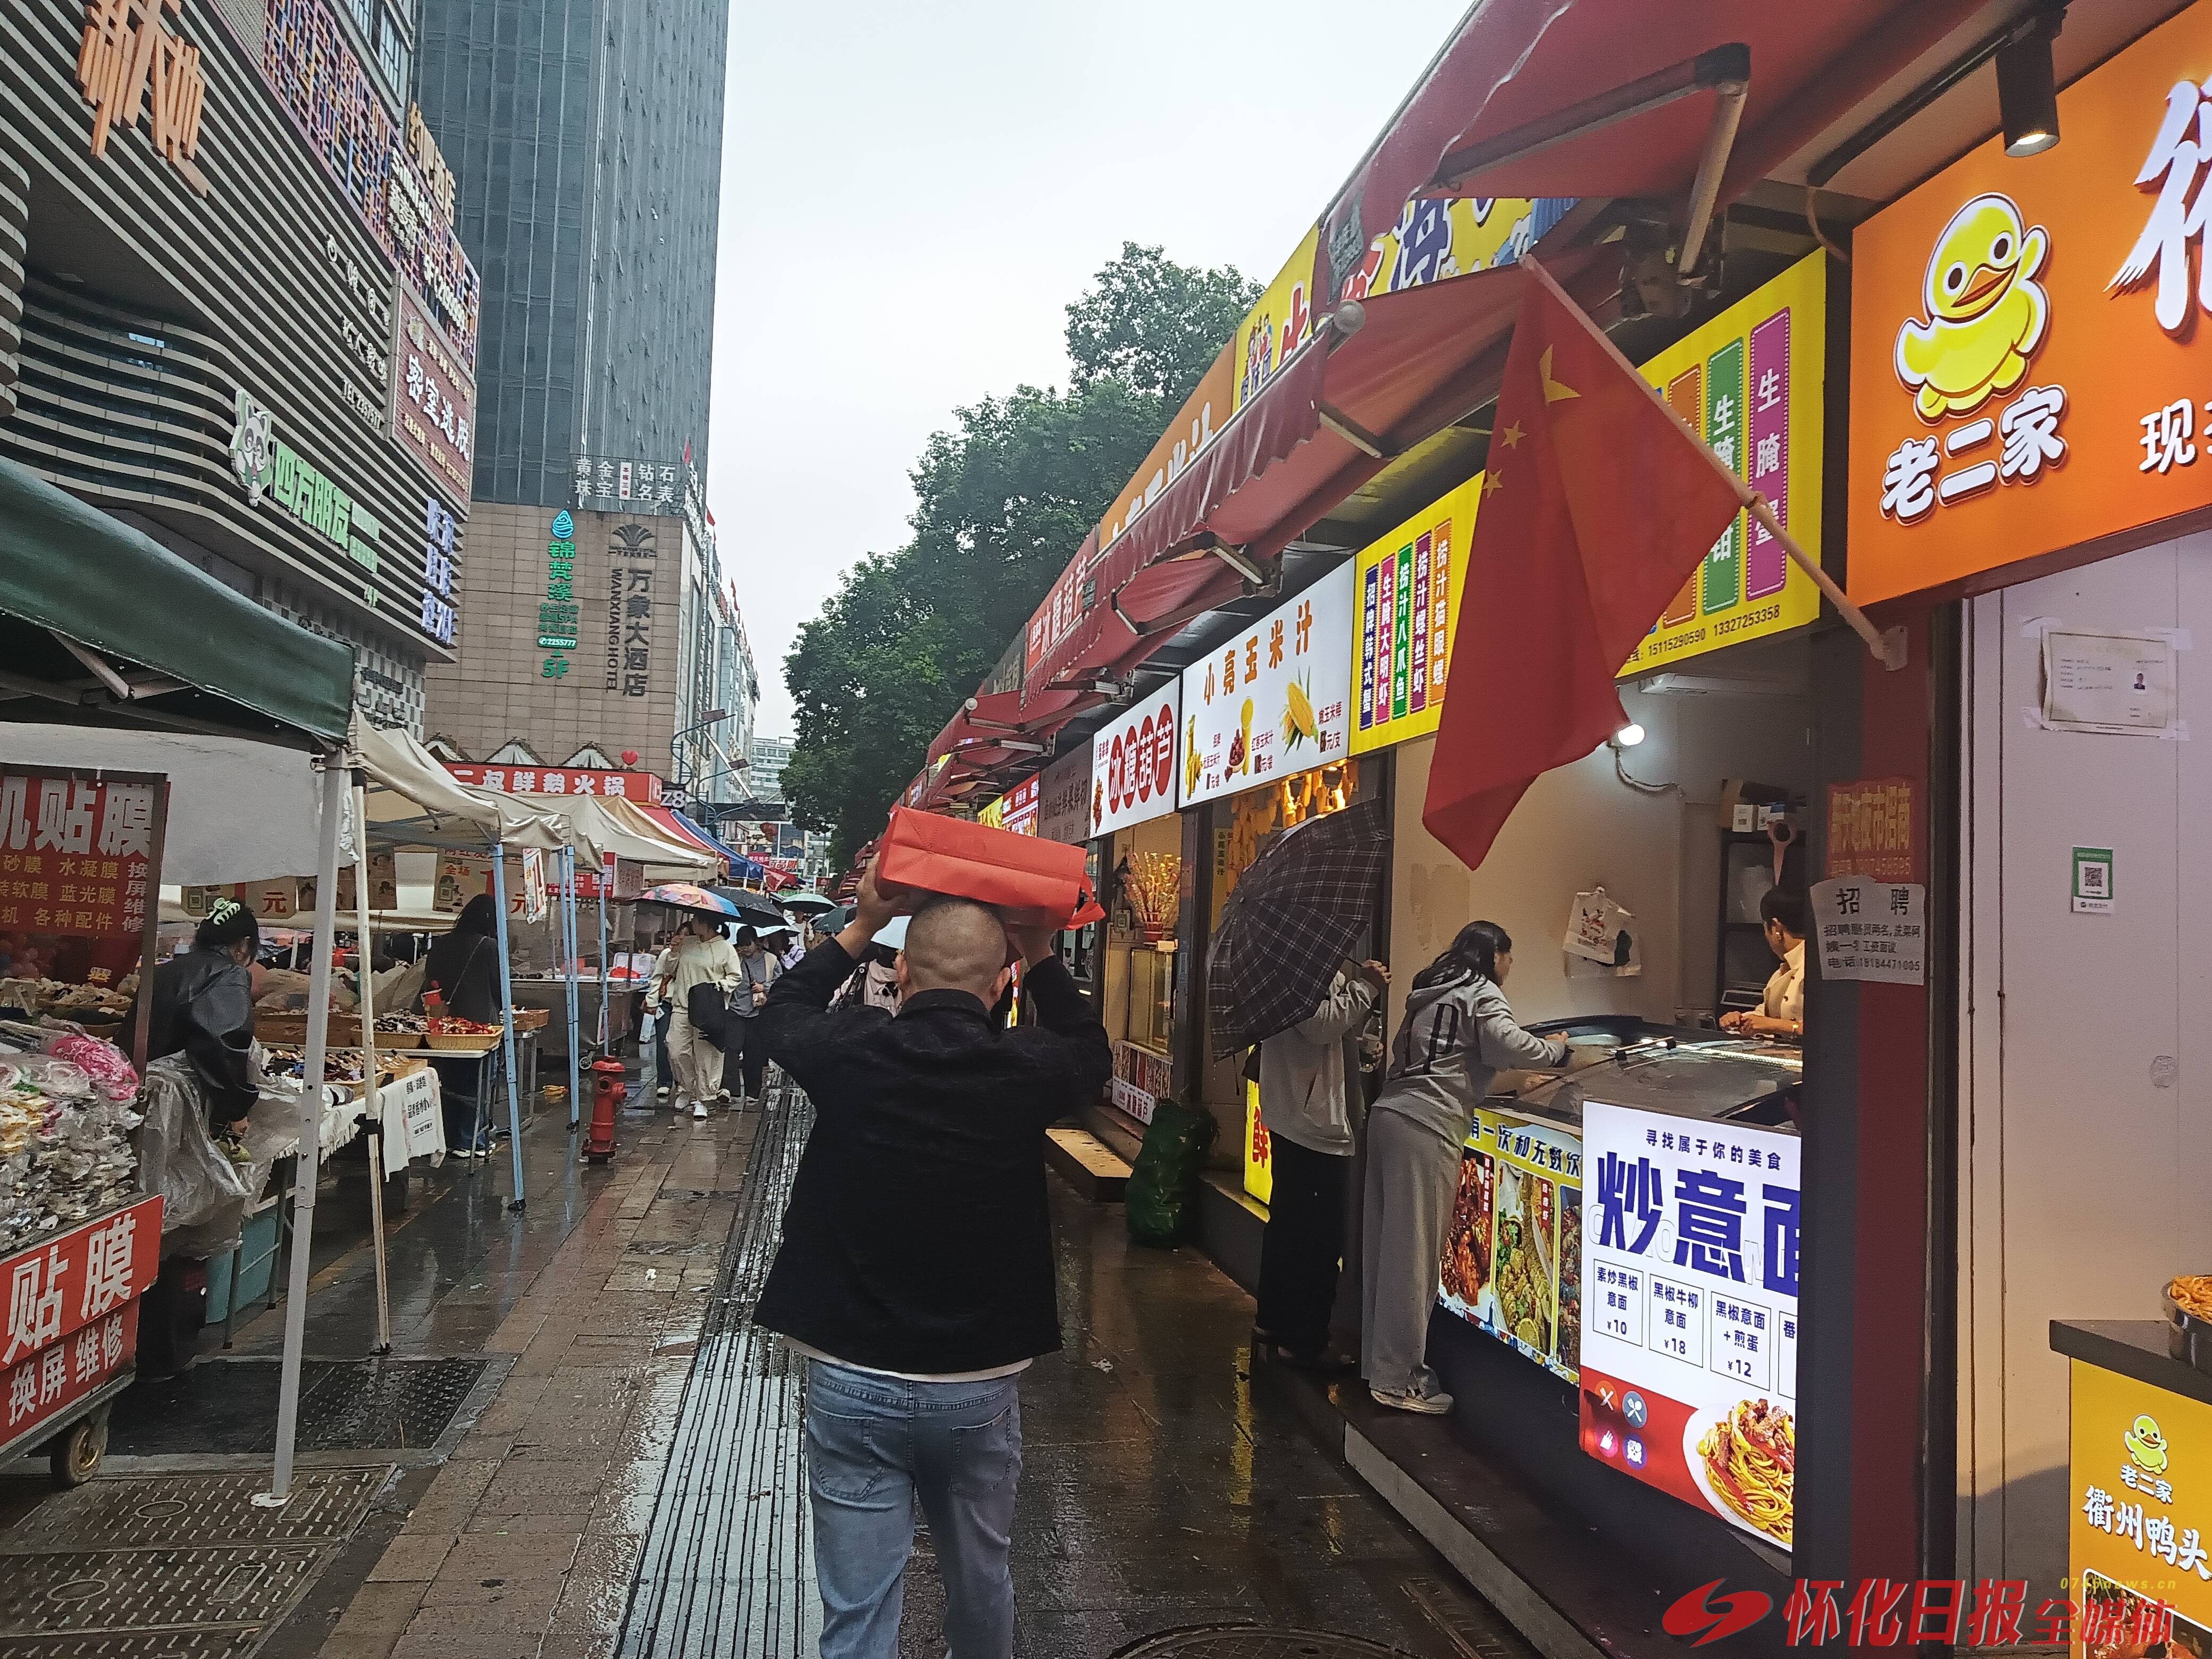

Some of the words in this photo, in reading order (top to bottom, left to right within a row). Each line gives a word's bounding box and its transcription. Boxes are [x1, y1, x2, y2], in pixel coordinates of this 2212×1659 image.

[406, 353, 470, 462] 密室逃脱
[2139, 398, 2212, 474] 现
[576, 458, 614, 477] 黄金
[638, 463, 675, 482] 钻石
[1881, 384, 2068, 526] 老二家
[574, 479, 613, 498] 珠宝
[639, 483, 674, 502] 名表
[1710, 393, 1737, 564] 生腌钳
[608, 568, 623, 646] WANXIANG
[1412, 550, 1430, 694] 捞汁螺丝虾
[623, 568, 652, 697] 万象大酒店
[1378, 573, 1392, 707] 生腌大明虾
[1394, 563, 1410, 701] 捞汁八爪鱼
[1648, 626, 1706, 658] 15115290590
[1713, 604, 1780, 637] 13327253358
[542, 659, 569, 678] 5F
[606, 647, 619, 693] HOTEL
[1109, 721, 1173, 801] 冰糖葫芦
[58, 858, 119, 879] 水凝膜
[445, 865, 472, 877] 全场
[59, 884, 116, 905] 蓝光膜
[263, 892, 287, 914] 元
[1836, 886, 1909, 916] 招聘
[34, 907, 113, 931] 各种配件
[1646, 1128, 1781, 1171] 寻找属于你的美食
[2, 1212, 137, 1365] 贴膜
[1597, 1267, 1639, 1292] 素炒黑椒
[1607, 1291, 1628, 1311] 意面
[1653, 1281, 1699, 1310] 黑椒牛柳
[1607, 1319, 1628, 1336] ¥10
[1664, 1308, 1687, 1329] 意面
[1715, 1300, 1766, 1330] 黑椒意面
[1664, 1337, 1687, 1355] ¥18
[1728, 1359, 1752, 1378] ¥12
[2120, 1463, 2173, 1505] 老二家
[2083, 1485, 2212, 1581] 衢州鸭头
